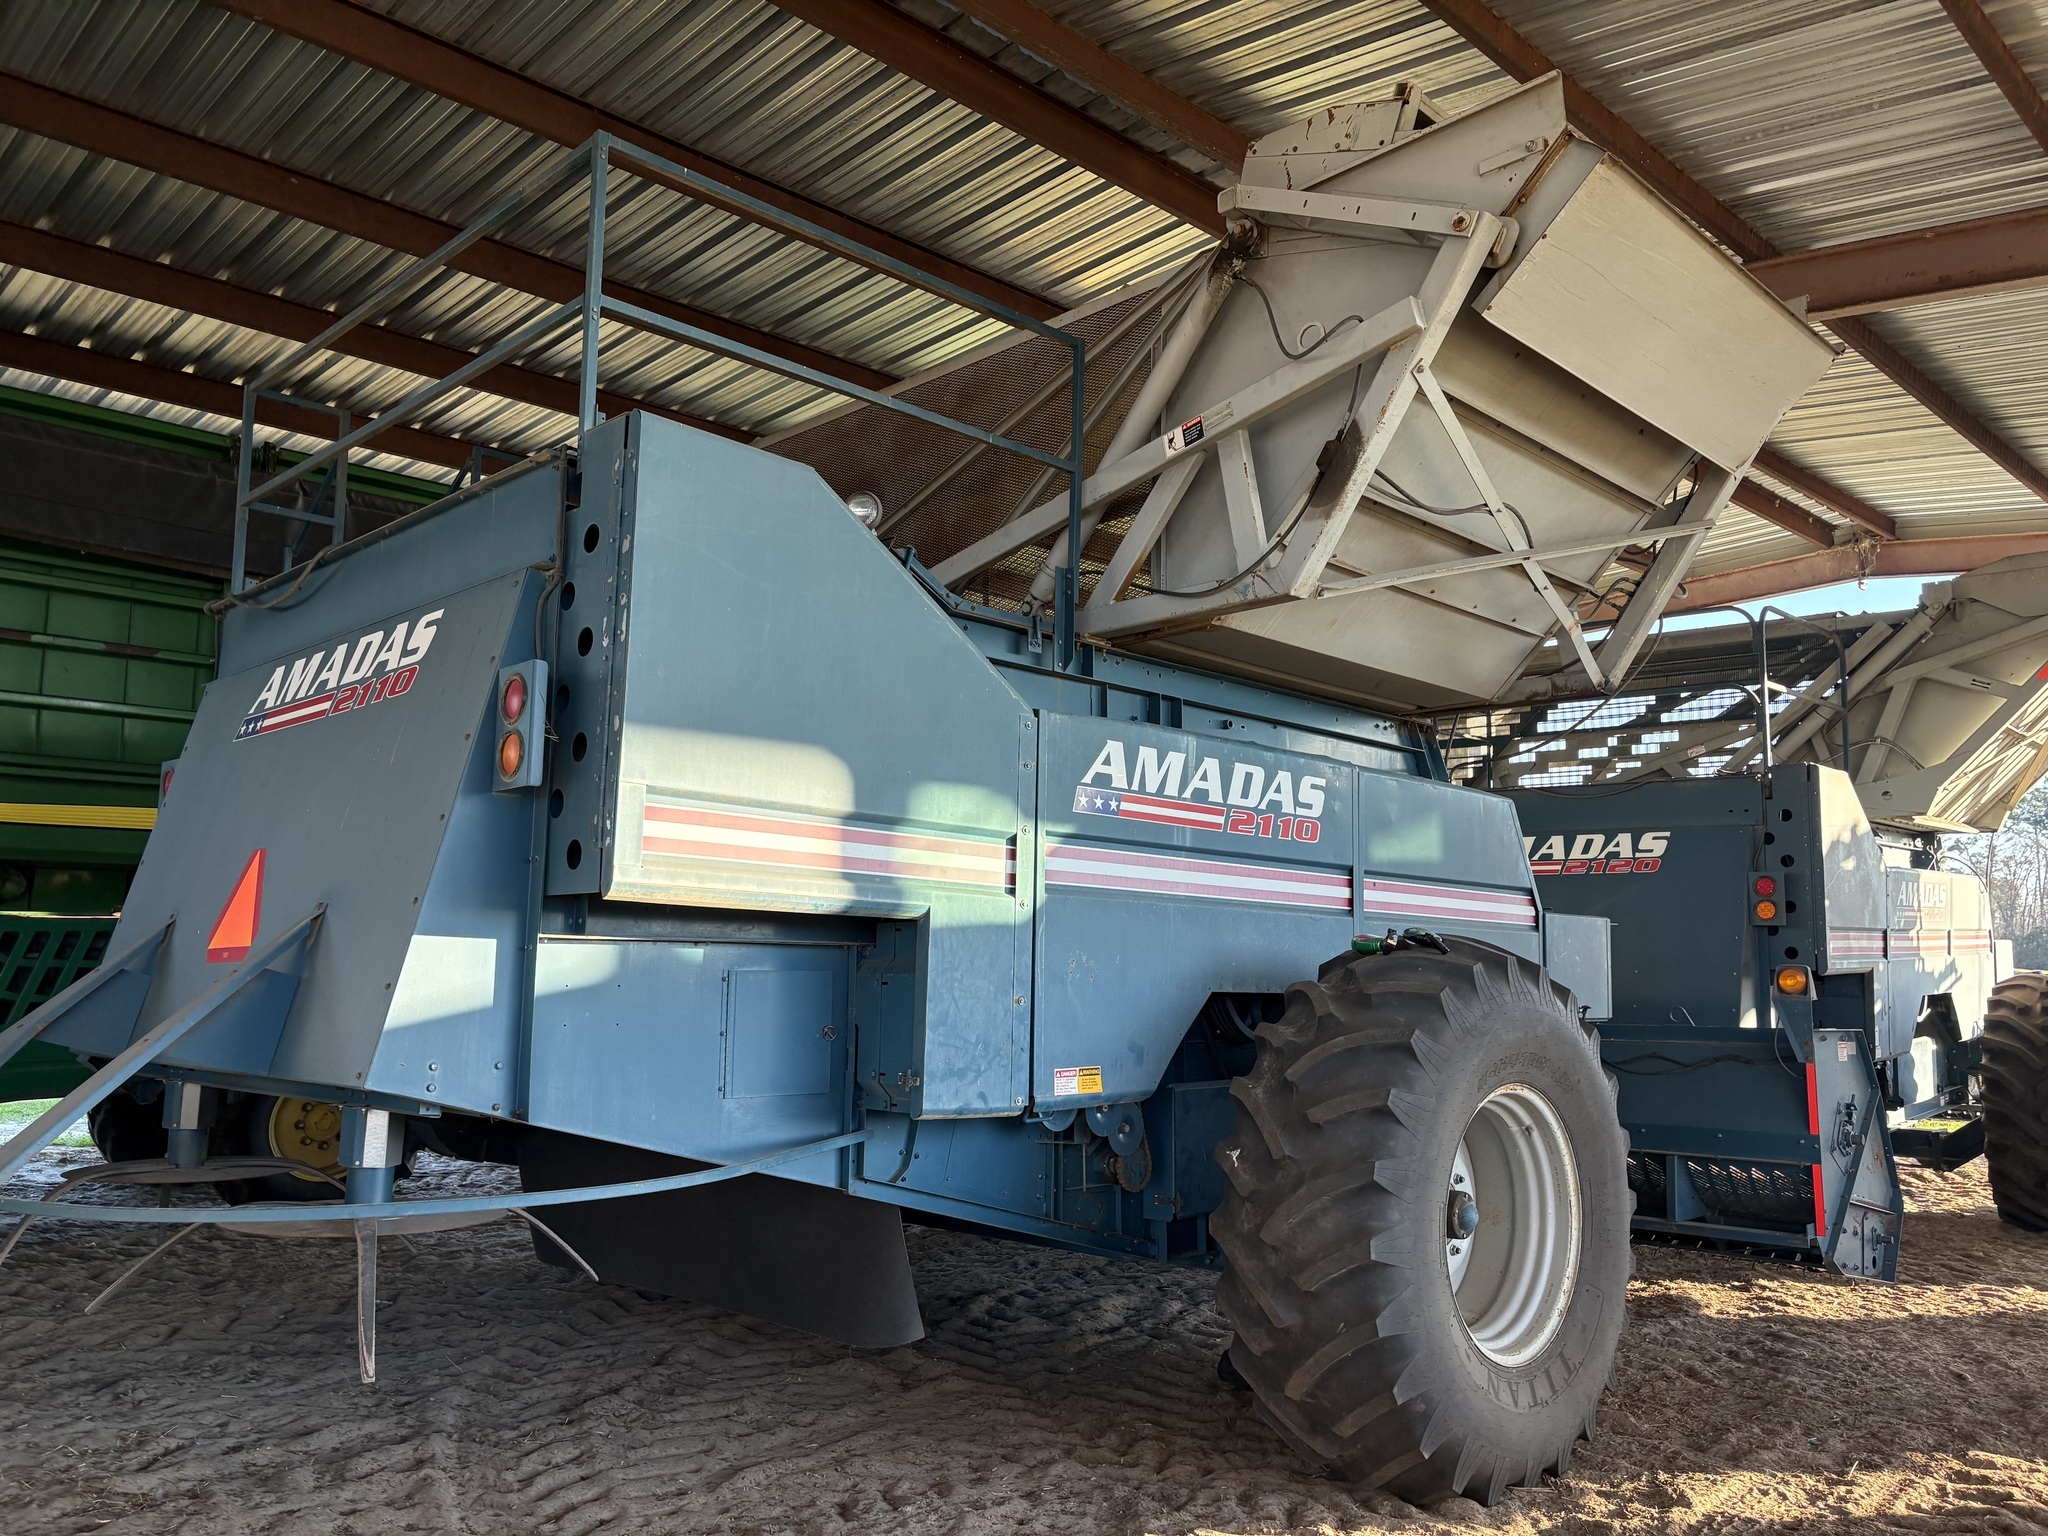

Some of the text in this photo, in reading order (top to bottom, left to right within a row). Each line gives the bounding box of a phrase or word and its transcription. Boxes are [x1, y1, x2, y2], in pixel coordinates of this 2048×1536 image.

[248, 607, 445, 714] AMADAS
[329, 664, 420, 717] 2110
[1080, 739, 1327, 818] AMADAS
[1227, 809, 1321, 844] 2110
[1562, 858, 1662, 876] 2120
[1896, 881, 1947, 907] AMADAS
[1487, 1347, 1578, 1412] TITAN
